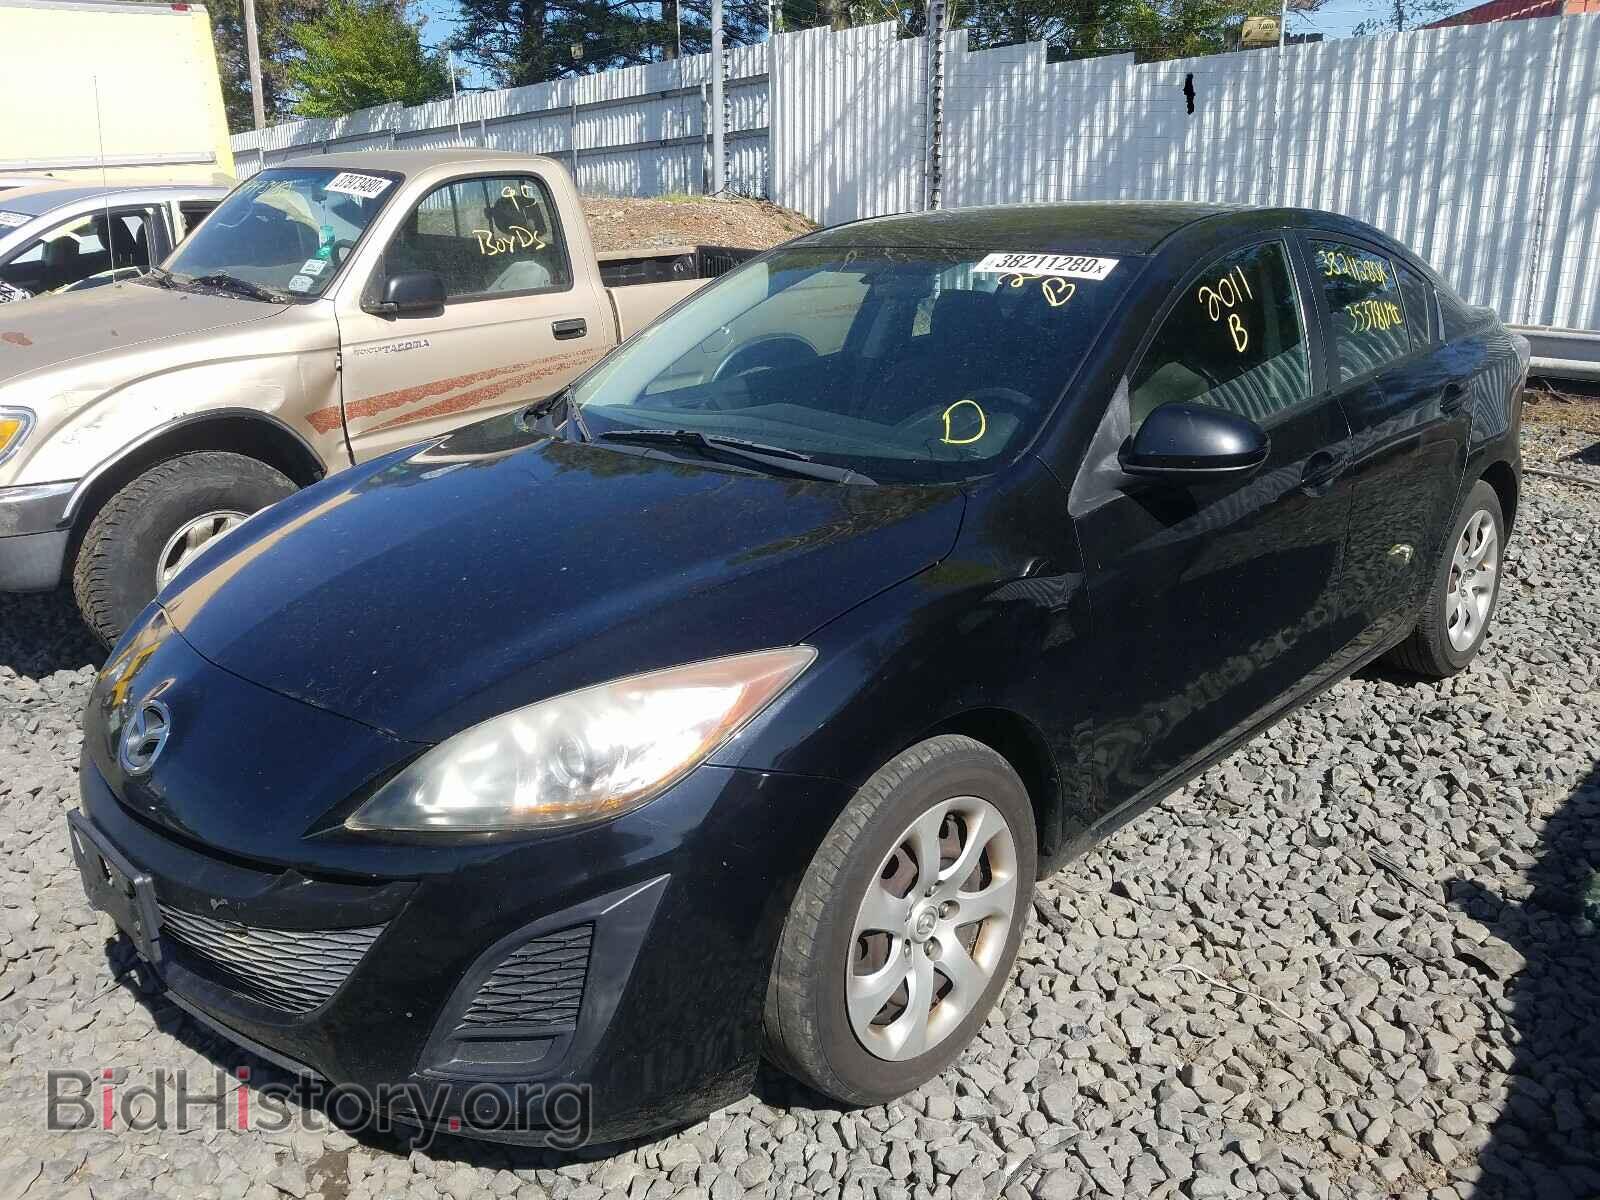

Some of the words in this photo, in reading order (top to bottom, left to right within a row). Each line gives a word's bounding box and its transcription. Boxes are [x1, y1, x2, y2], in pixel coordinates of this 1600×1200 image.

[1198, 265, 1253, 321] 2011
[382, 339, 430, 354] TACOMA
[1227, 313, 1249, 353] B
[939, 399, 986, 445] D
